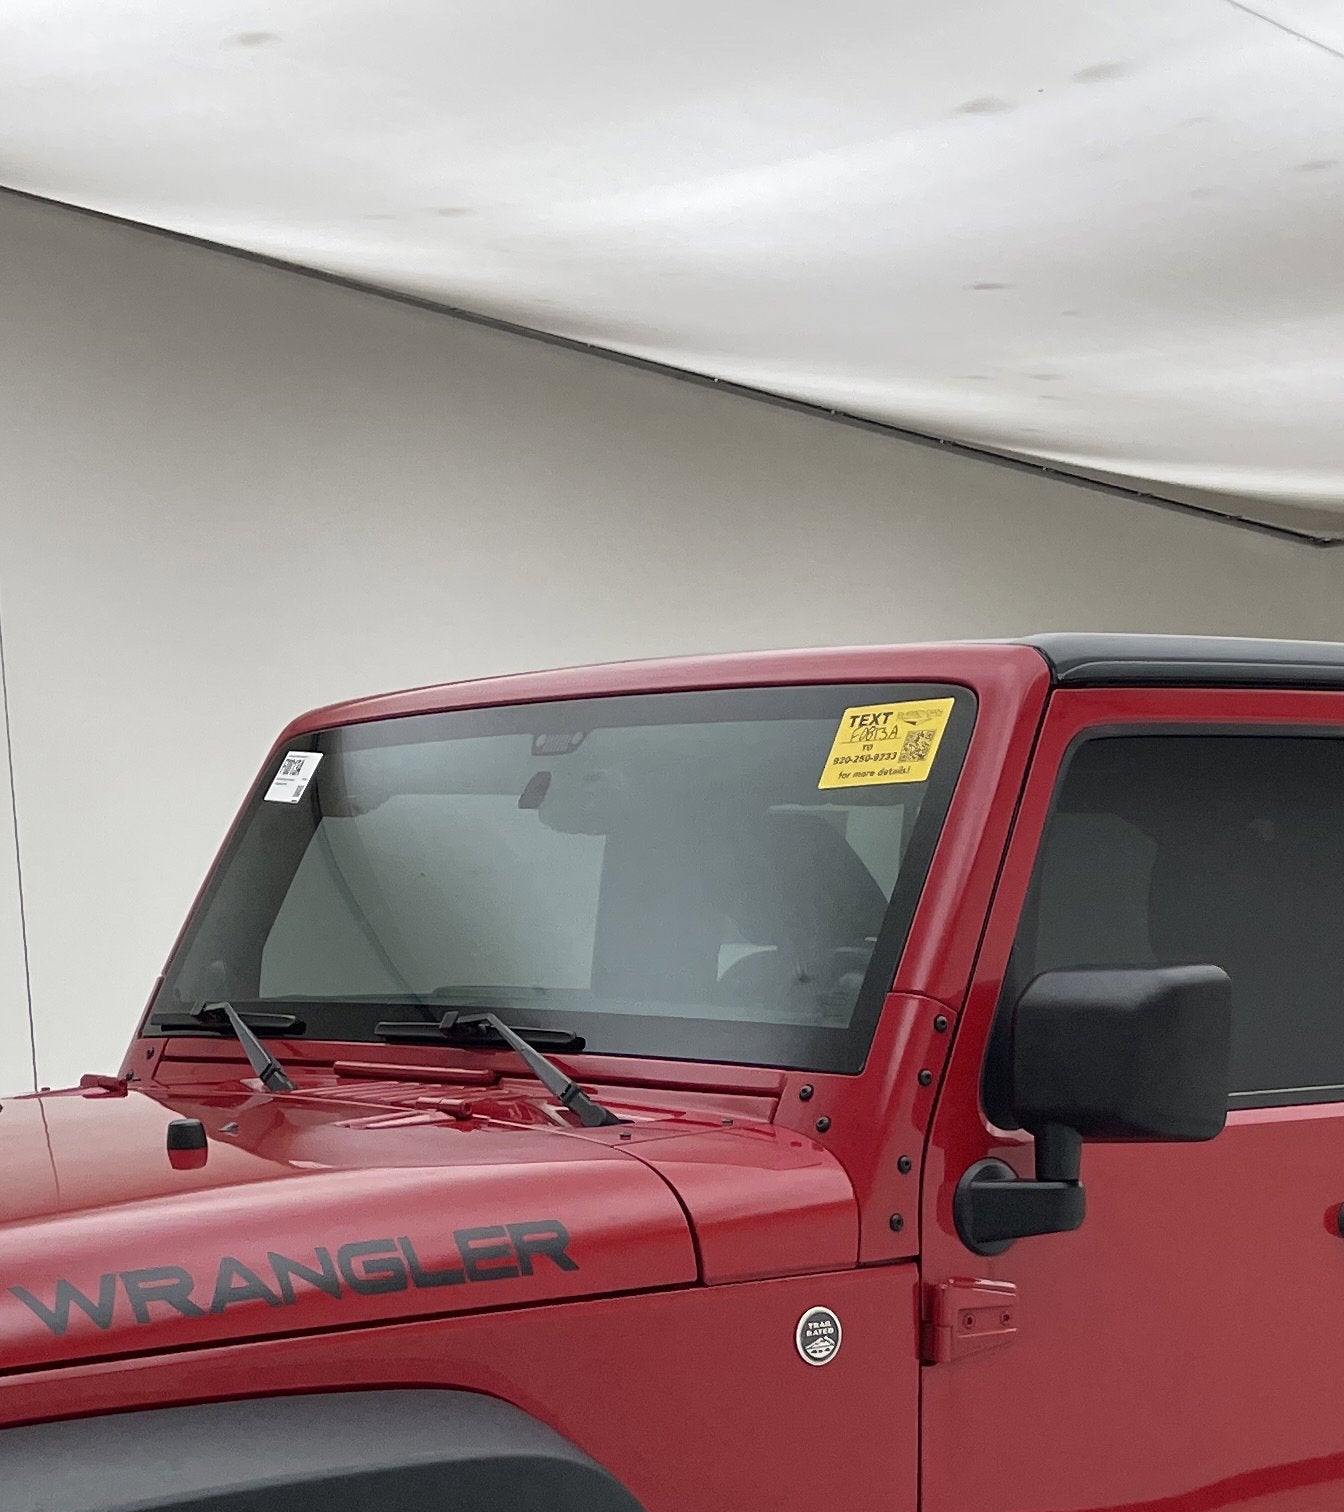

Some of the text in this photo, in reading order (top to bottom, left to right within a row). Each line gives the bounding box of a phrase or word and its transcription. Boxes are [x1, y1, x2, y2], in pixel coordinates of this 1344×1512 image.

[849, 711, 893, 728] TEXT
[838, 765, 911, 779] for more details!
[7, 1219, 580, 1337] WRANGLER
[806, 1327, 835, 1337] RATED
